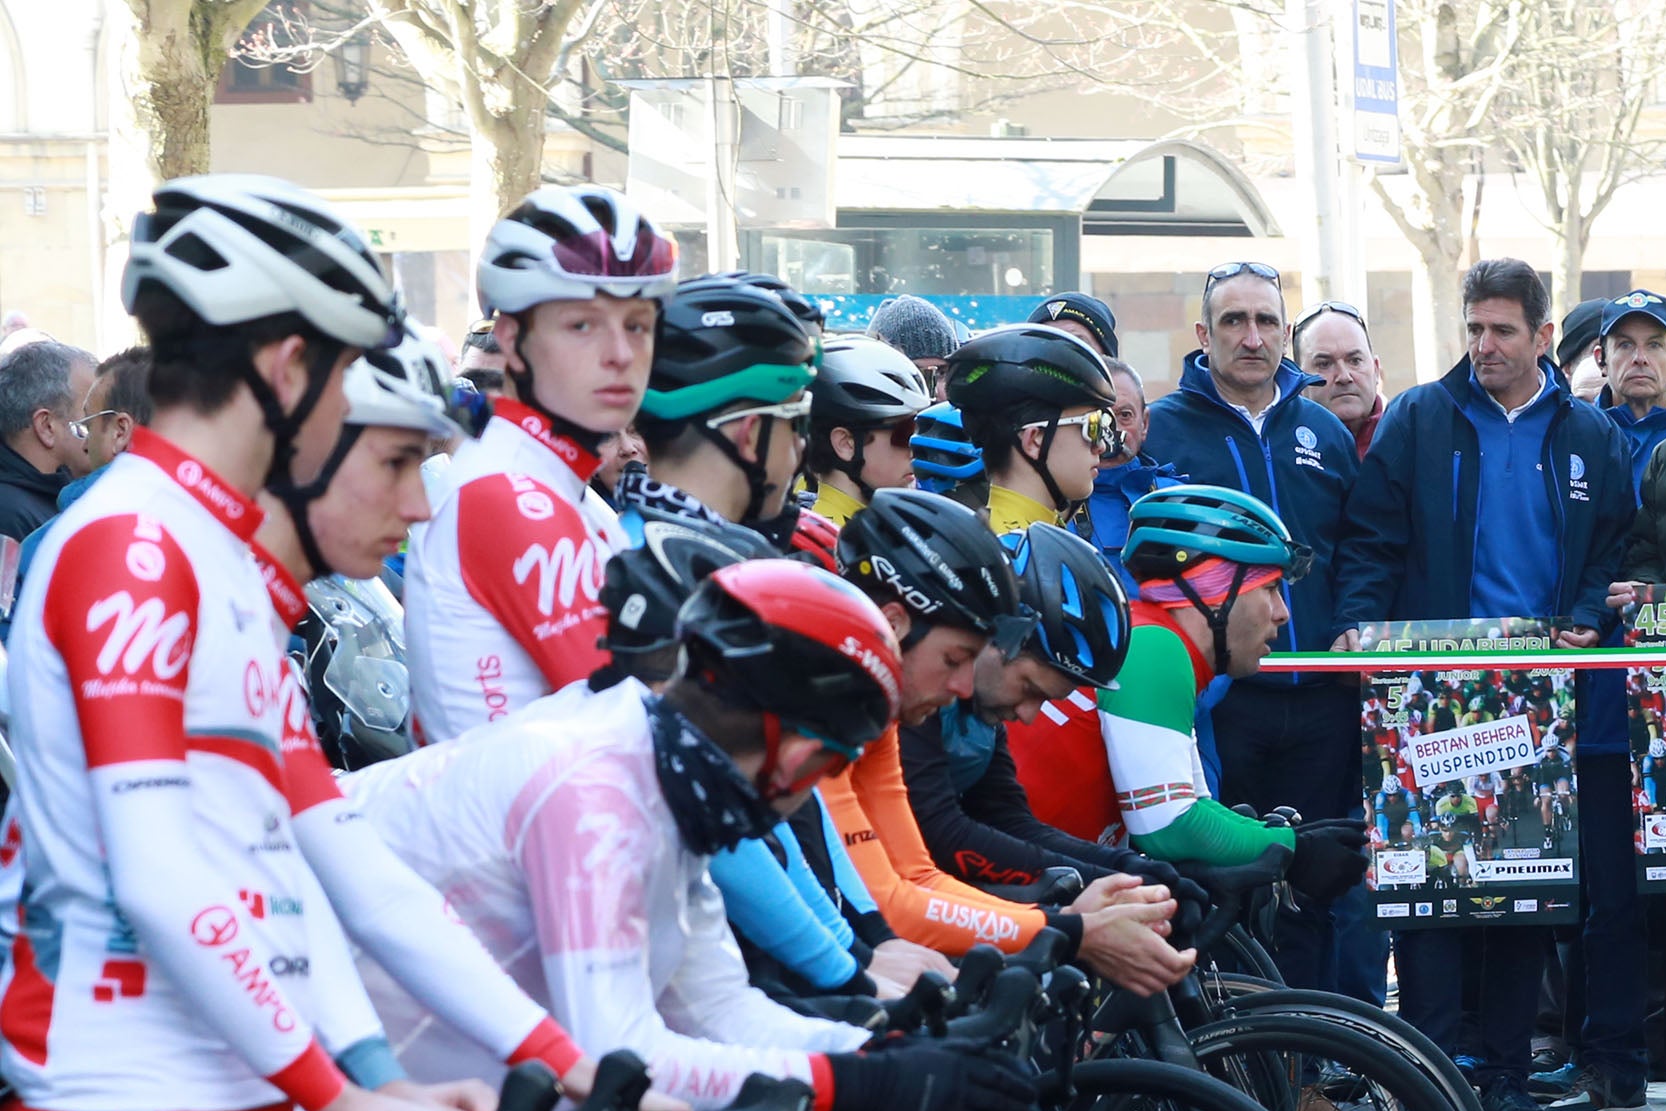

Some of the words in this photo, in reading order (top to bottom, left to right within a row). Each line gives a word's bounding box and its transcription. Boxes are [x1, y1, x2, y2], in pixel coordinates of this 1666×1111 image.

[1231, 514, 1274, 539] LAZER
[1387, 686, 1402, 709] 5
[1415, 735, 1469, 758] BERTAN
[1473, 723, 1526, 748] BEHERA
[1420, 743, 1529, 778] SUSPENDIDO
[1495, 862, 1571, 875] PNEUMAX
[925, 898, 1021, 944] EUSKADI
[222, 947, 296, 1034] AMPO
